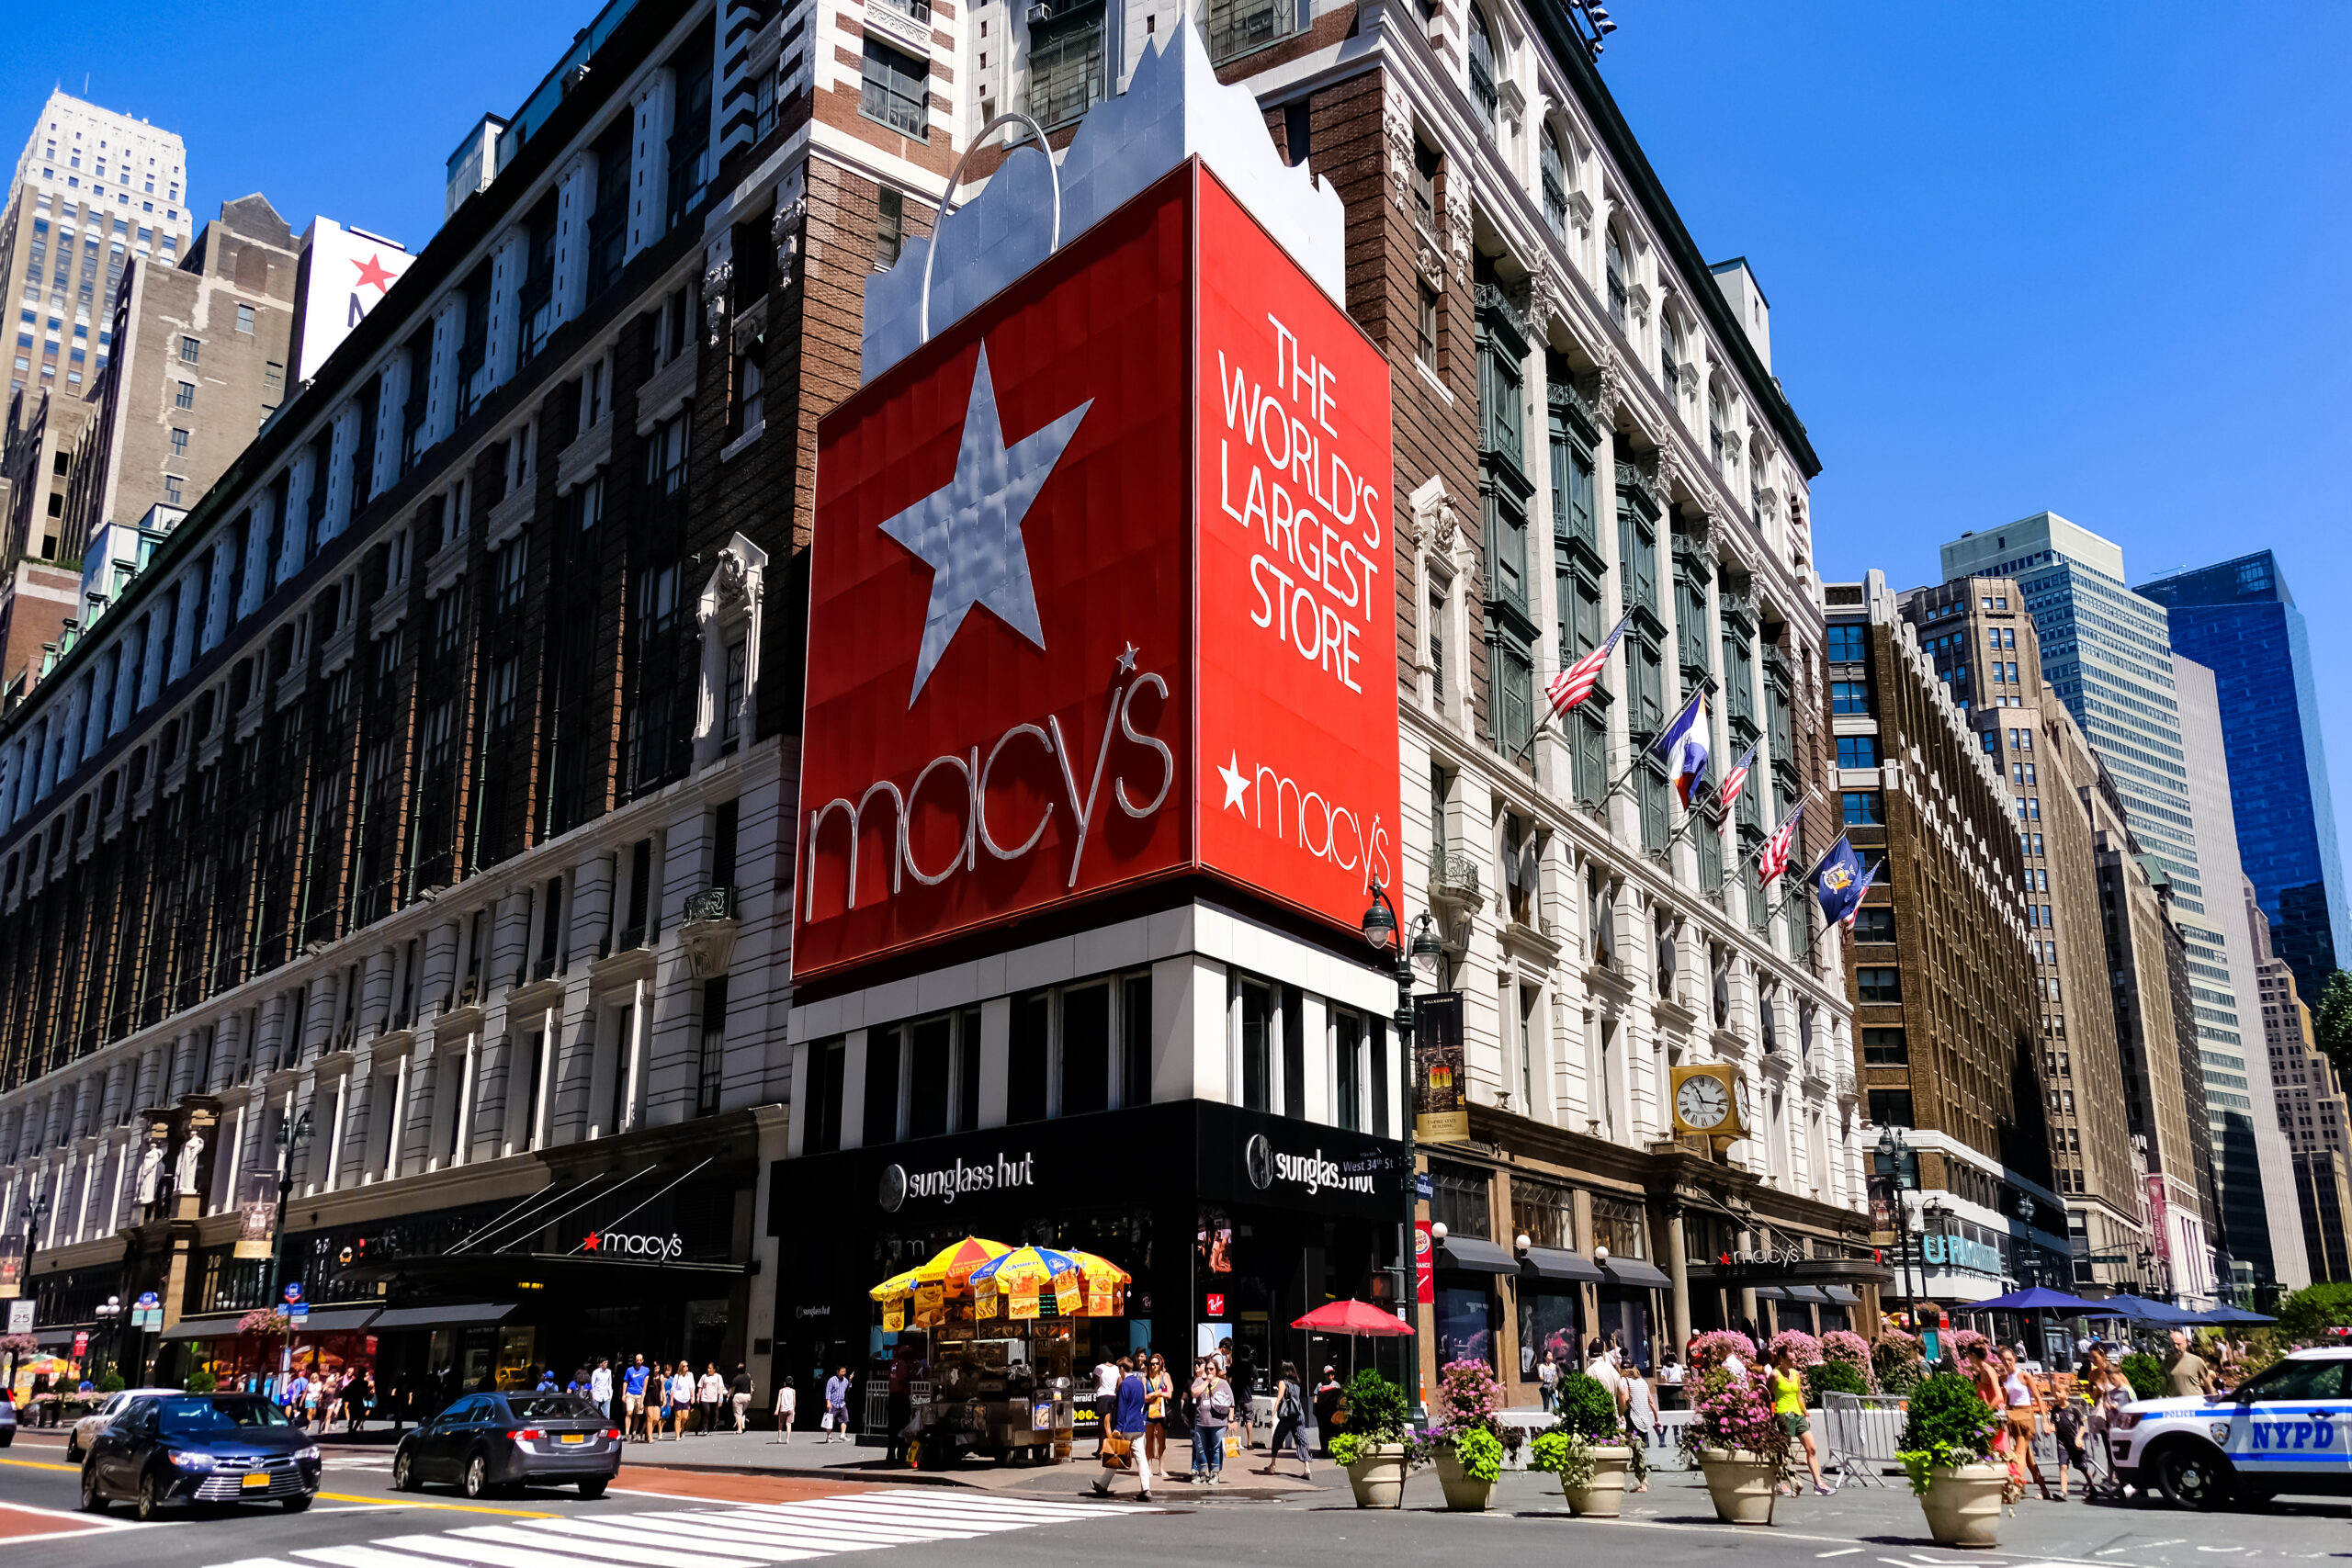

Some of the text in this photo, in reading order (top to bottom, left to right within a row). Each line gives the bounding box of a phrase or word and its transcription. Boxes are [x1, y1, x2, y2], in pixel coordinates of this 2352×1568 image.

[1267, 312, 1338, 440] THE
[1217, 348, 1381, 550] WORLD'S
[1220, 437, 1378, 623] LARGEST
[1250, 553, 1362, 694] STORE
[806, 641, 1174, 923] macy's
[1256, 761, 1390, 897] macy's
[909, 1151, 1035, 1205] sunglass hut
[1342, 1156, 1395, 1172] West 34th St
[1417, 1181, 1434, 1199] roadway
[603, 1232, 683, 1261] macy's
[1733, 1244, 1800, 1269] macy's
[13, 1314, 30, 1324] 25
[911, 1394, 931, 1405] Subwa
[2165, 1409, 2195, 1419] POLICE
[2252, 1422, 2335, 1449] NYPD
